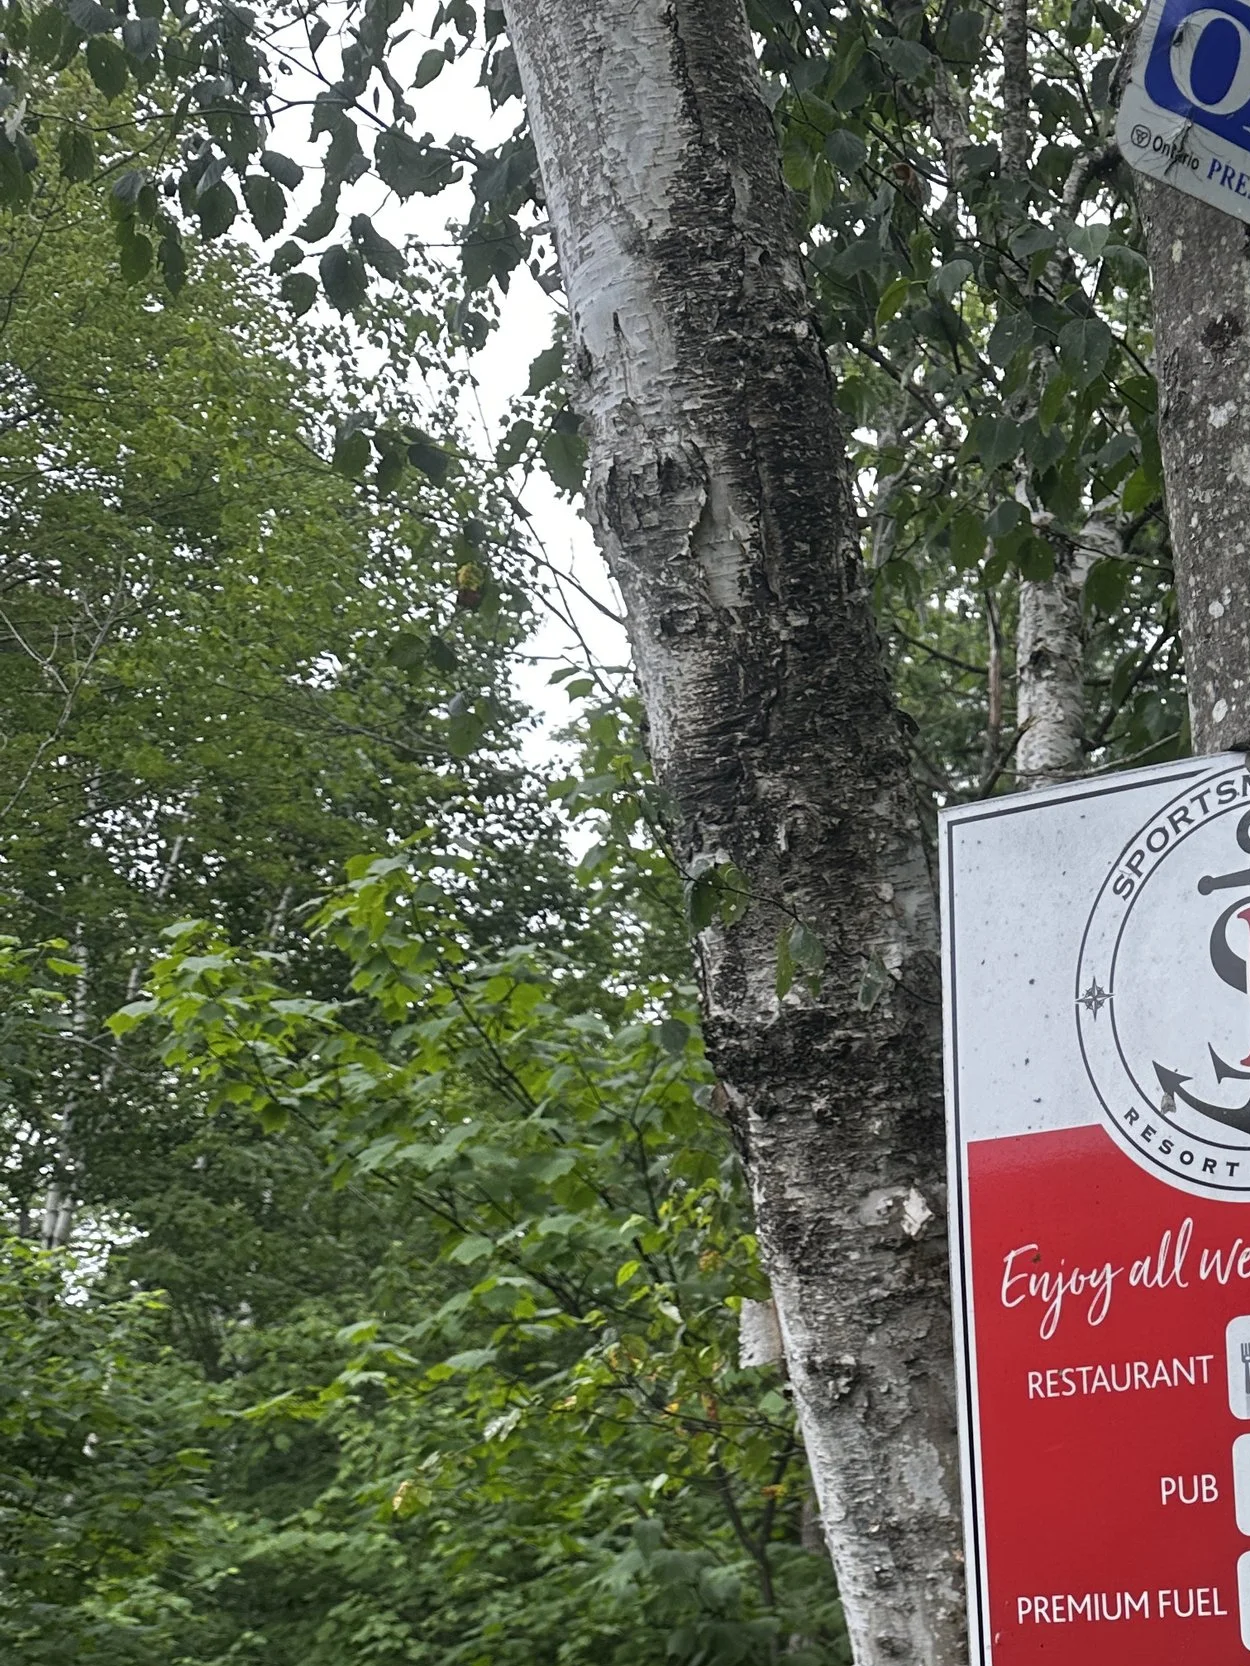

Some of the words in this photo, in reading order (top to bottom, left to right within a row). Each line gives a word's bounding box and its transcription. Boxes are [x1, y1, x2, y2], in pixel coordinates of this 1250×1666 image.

[1124, 1105, 1240, 1178] RESORT
[1000, 1243, 1124, 1339] Enjoy
[1128, 1217, 1194, 1288] all
[1027, 1355, 1215, 1399] RESTAURANT
[1160, 1474, 1219, 1505] PUB
[1017, 1590, 1150, 1624] PREMIUM
[1158, 1587, 1228, 1617] FUEL
